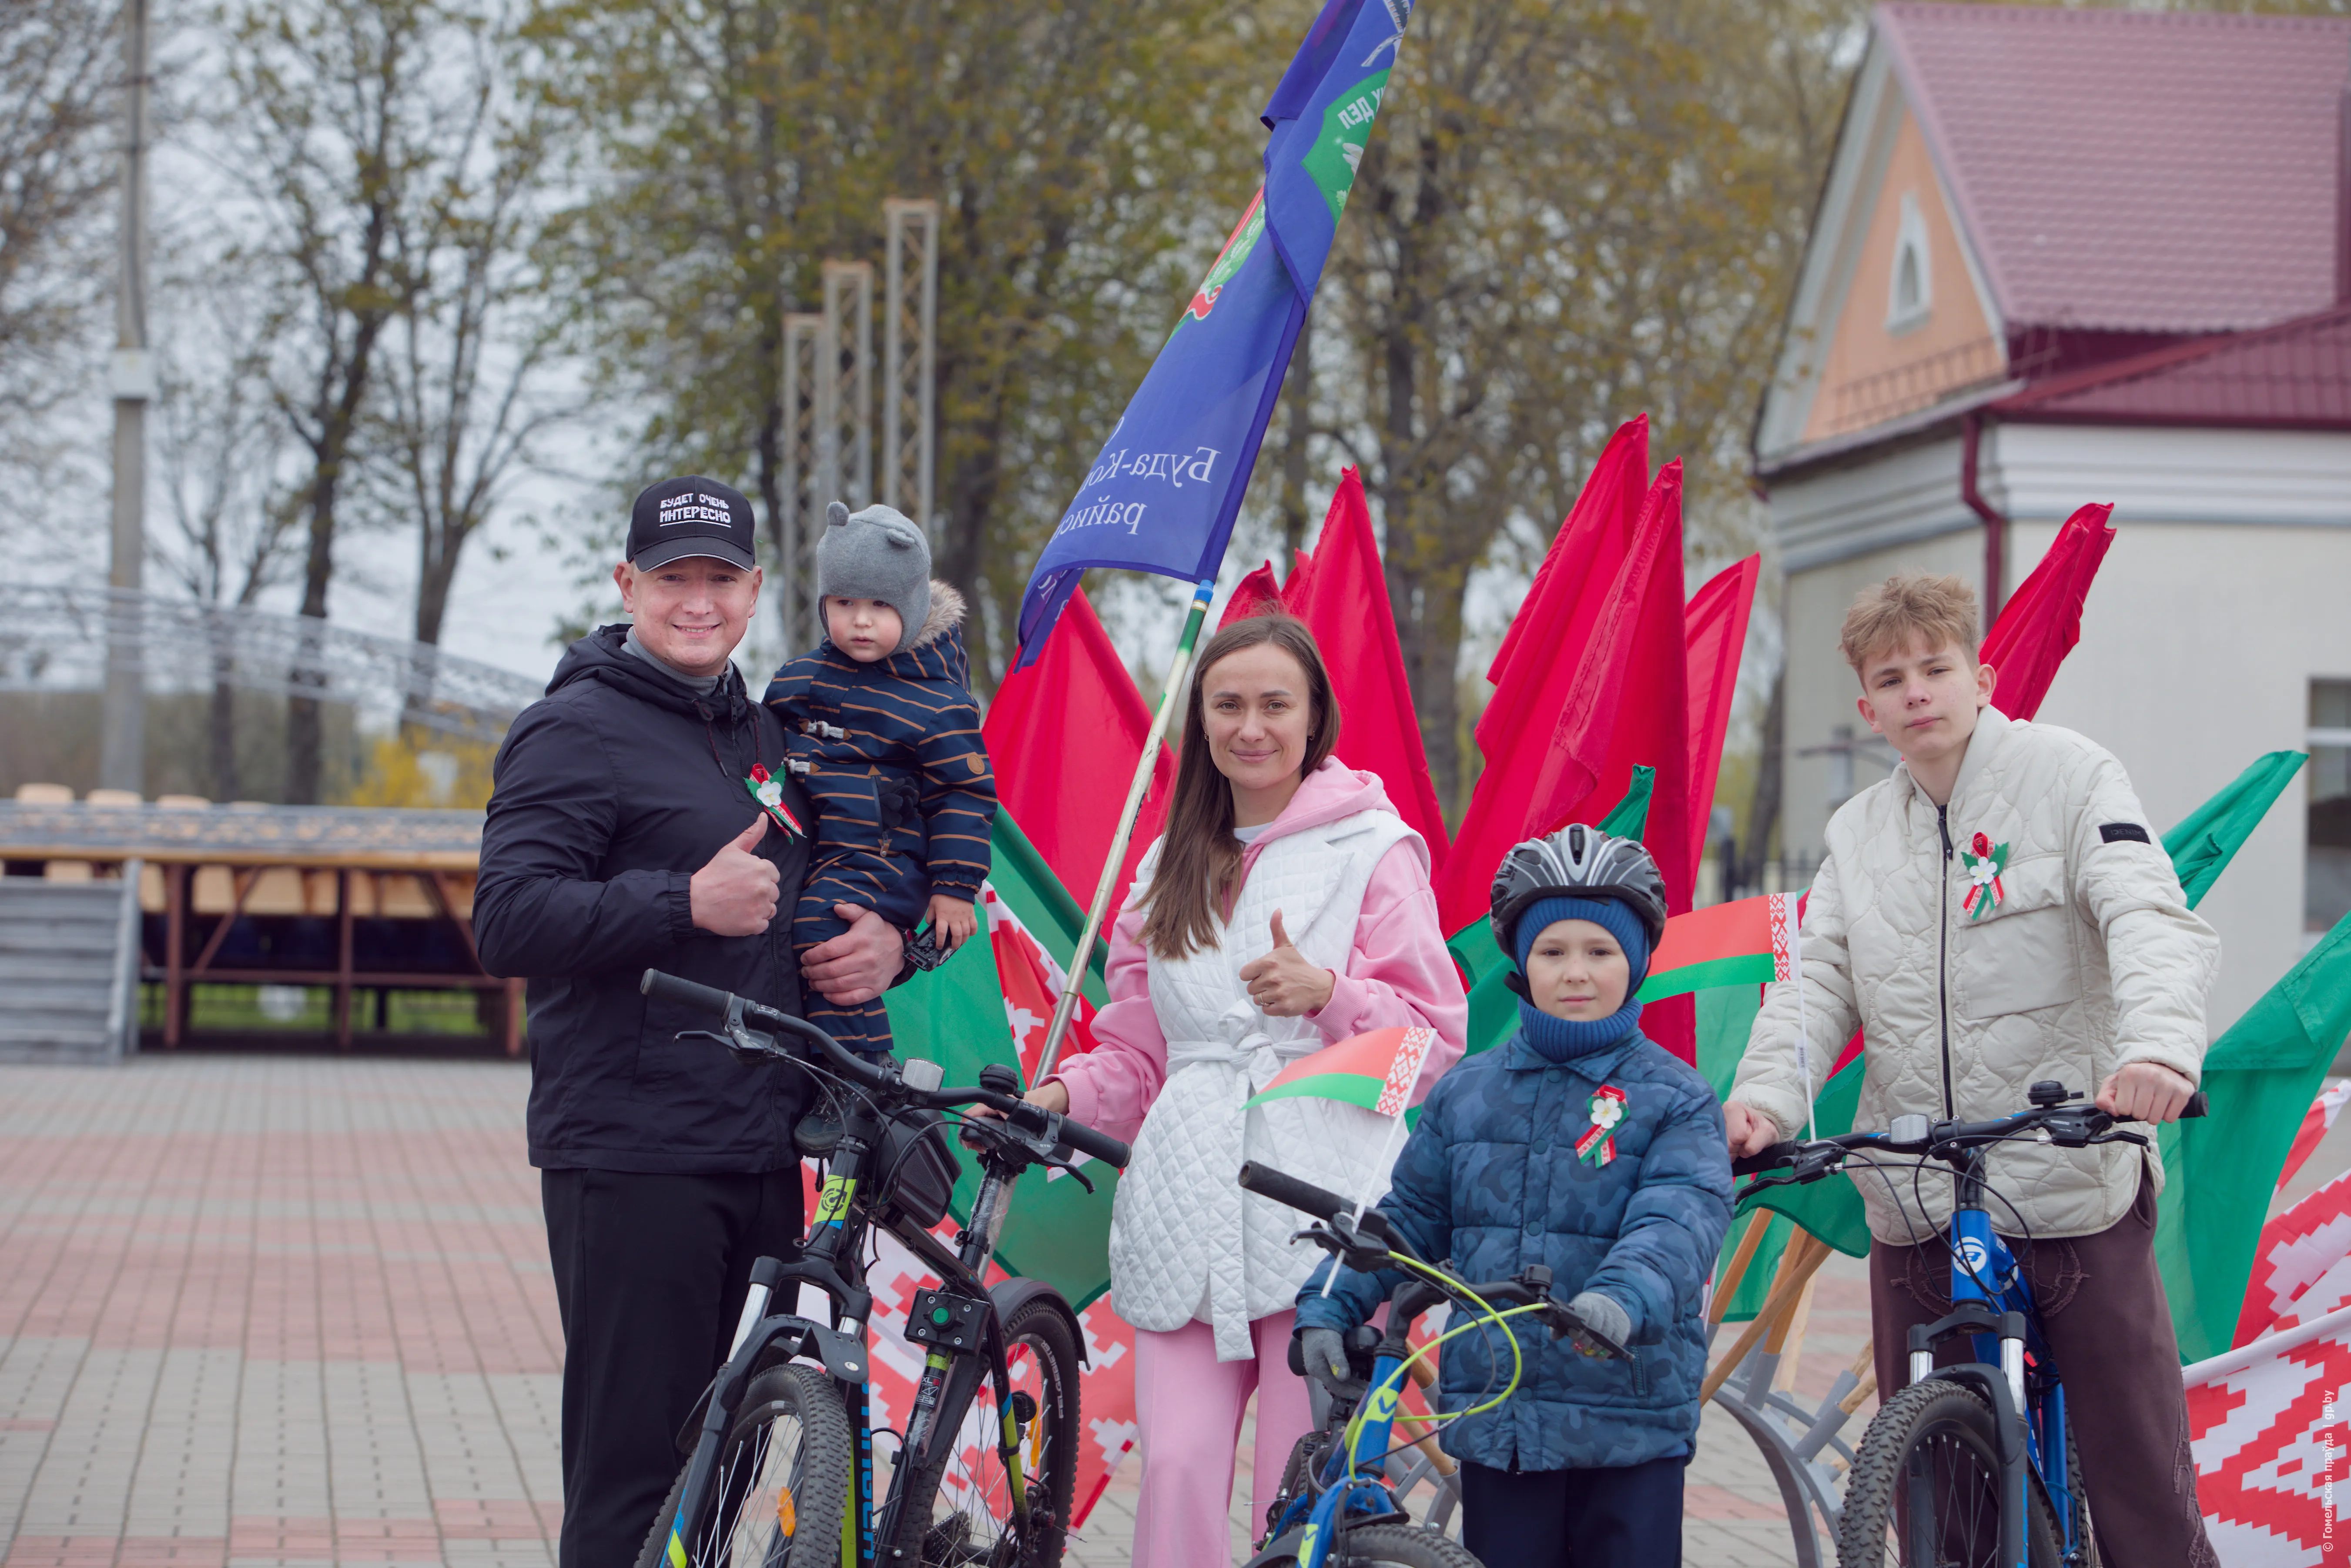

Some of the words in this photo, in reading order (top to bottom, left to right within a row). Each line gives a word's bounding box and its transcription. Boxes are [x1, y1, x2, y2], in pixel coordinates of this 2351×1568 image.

[660, 493, 693, 509] БУДЕТ
[699, 494, 729, 509] ОЧЕНЬ
[660, 506, 731, 523] ИНТЕРЕСНО
